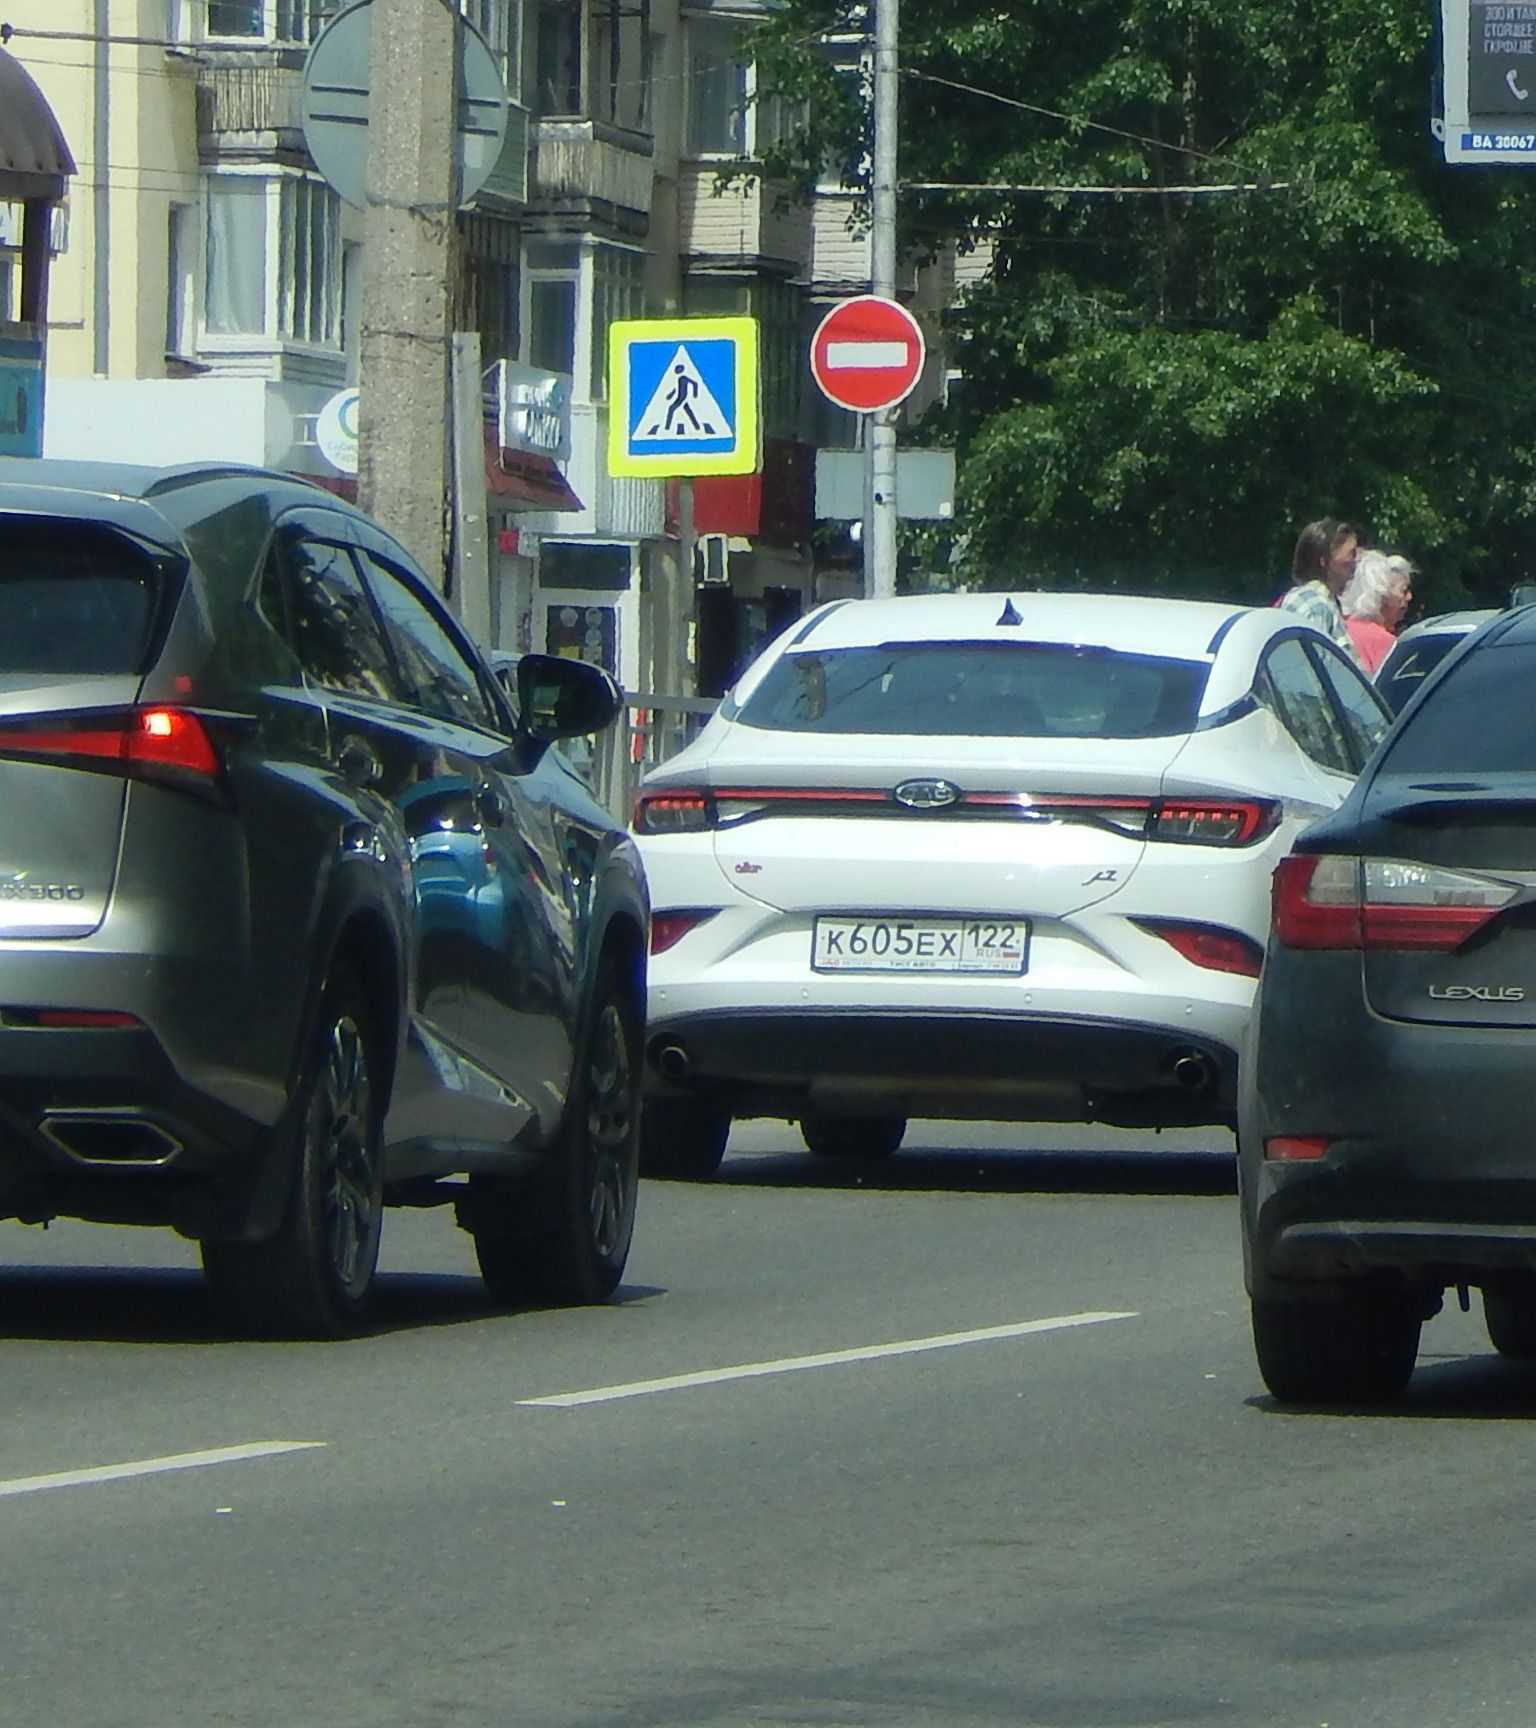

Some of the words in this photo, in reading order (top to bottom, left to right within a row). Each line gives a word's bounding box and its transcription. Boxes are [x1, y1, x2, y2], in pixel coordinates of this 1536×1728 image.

[827, 922, 958, 957] К605ЕХ
[967, 924, 1016, 948] 122
[1428, 984, 1525, 1001] LEXUS
